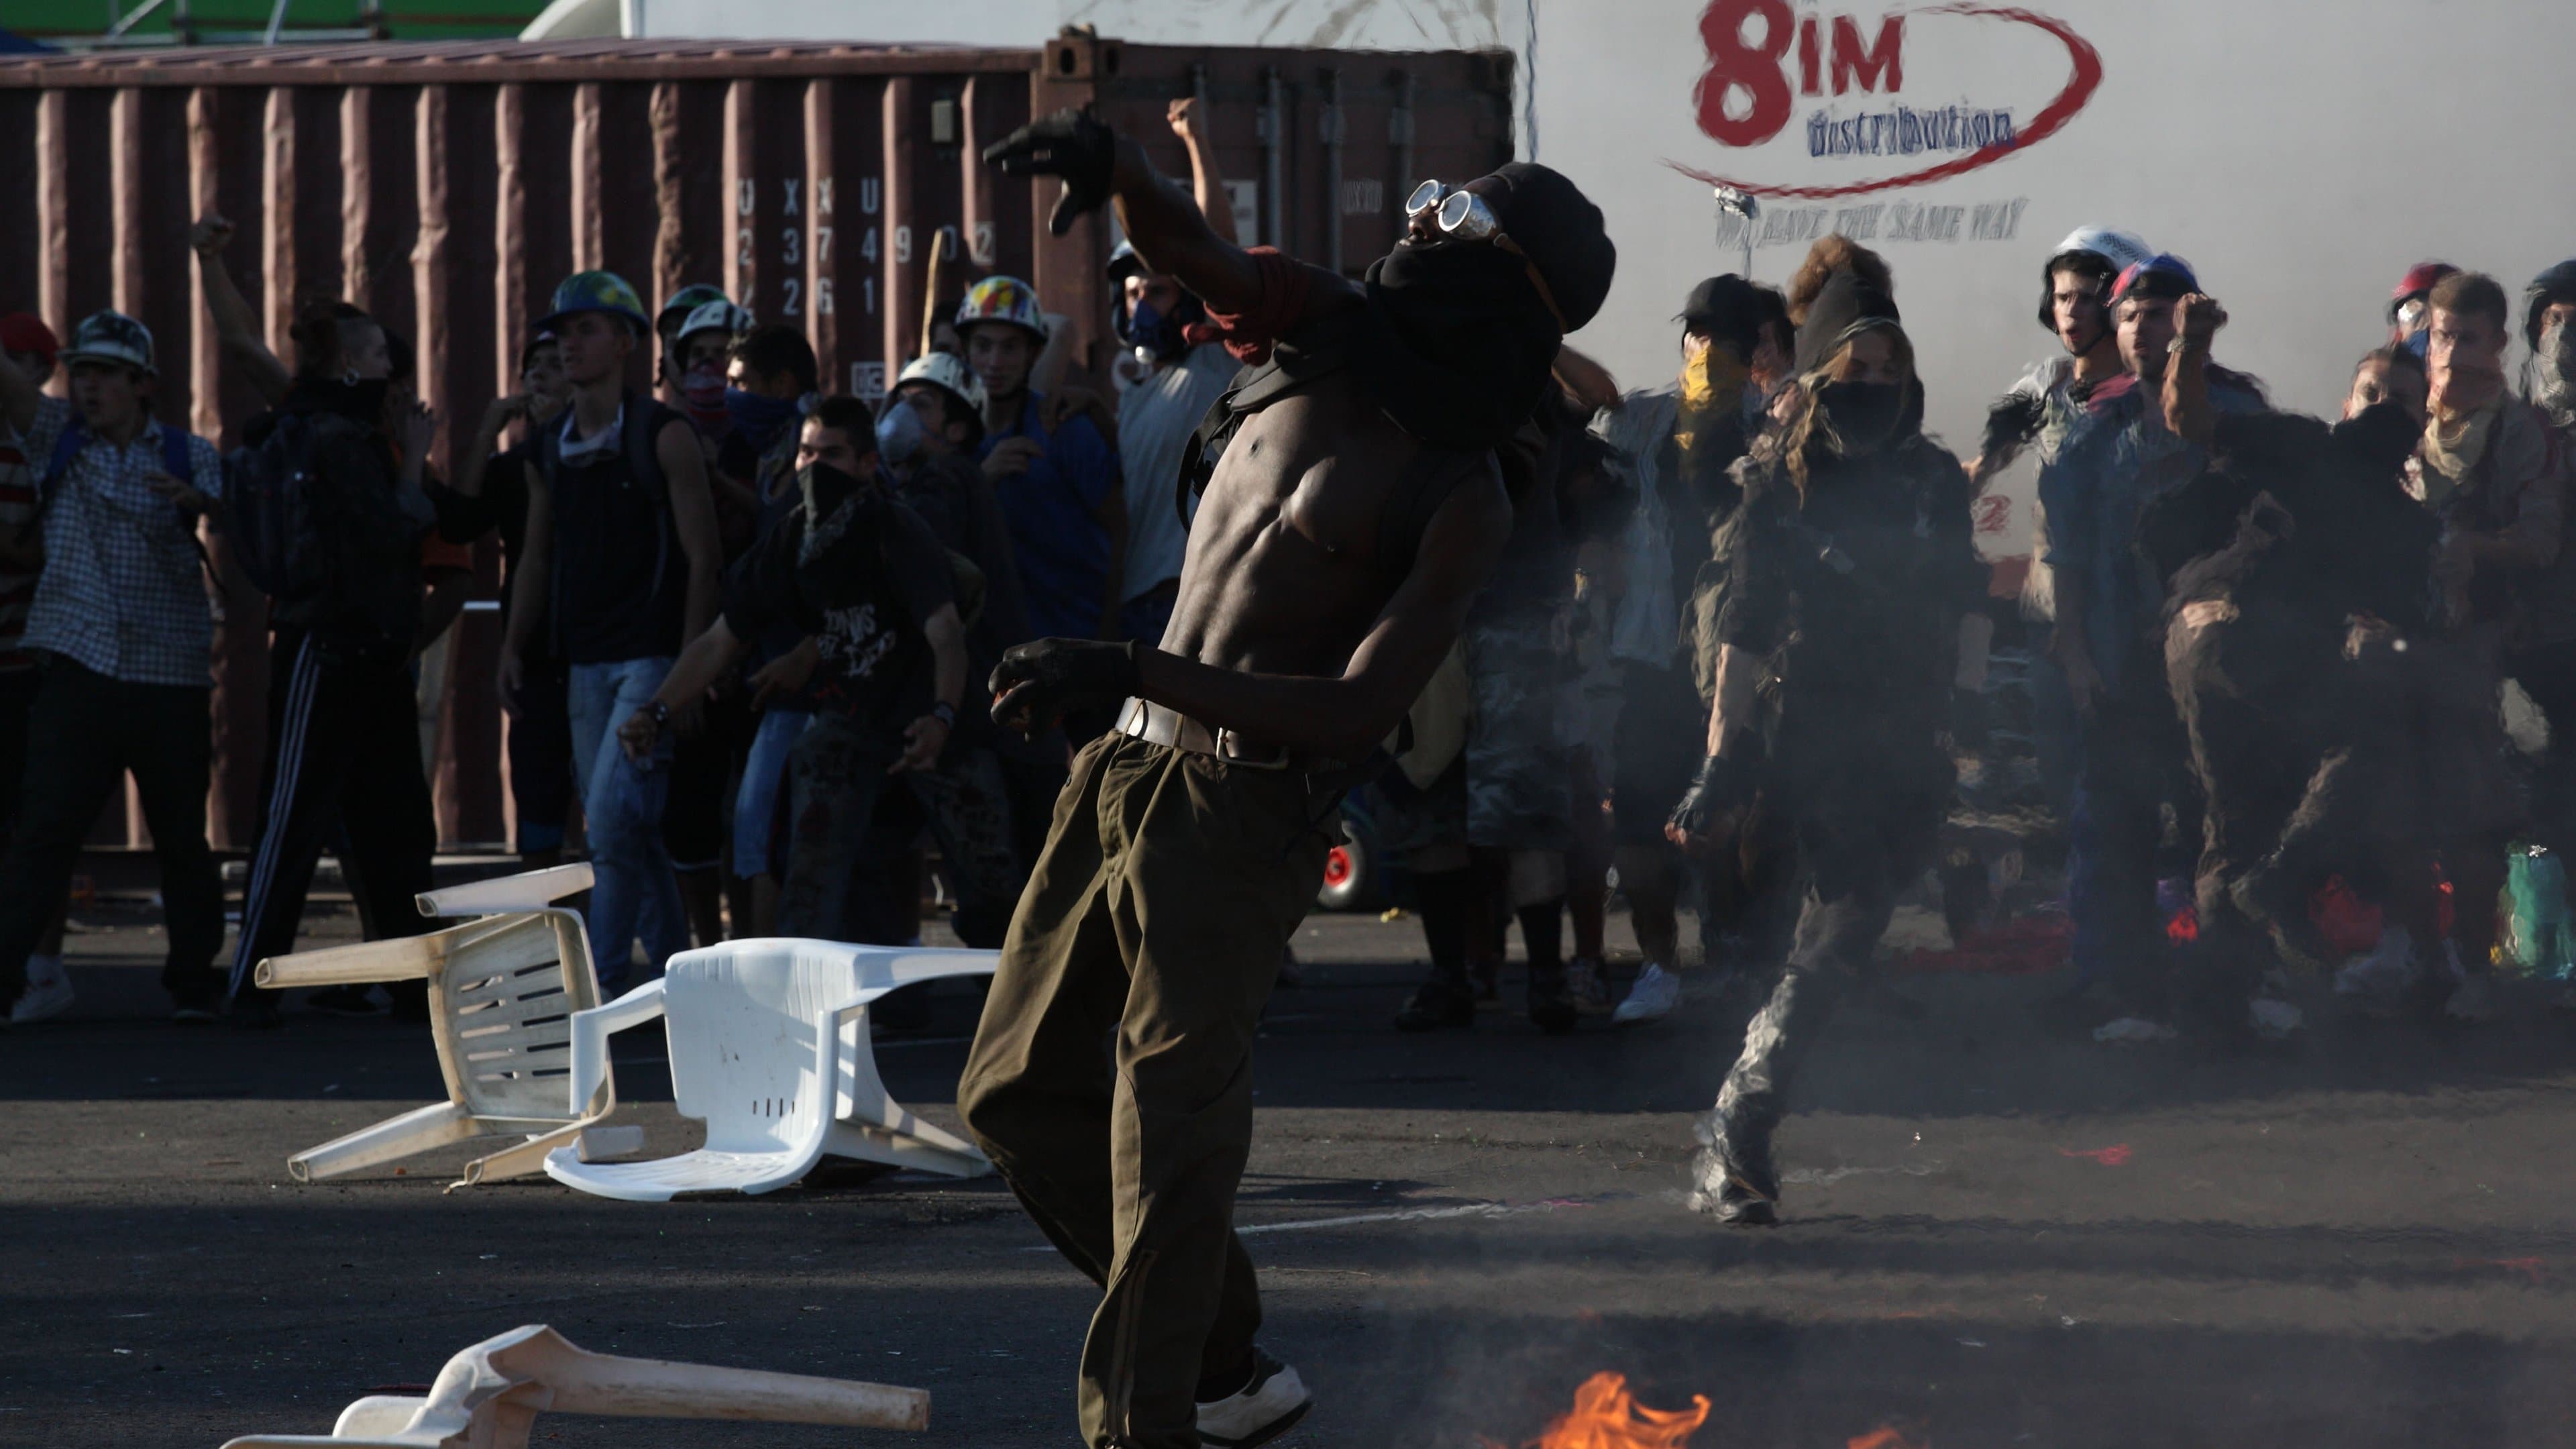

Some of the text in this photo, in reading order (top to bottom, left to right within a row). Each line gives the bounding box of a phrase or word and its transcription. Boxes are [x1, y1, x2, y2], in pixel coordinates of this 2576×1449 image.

[1807, 105, 2014, 156] distribution
[1887, 200, 1965, 243] SAME
[1969, 196, 2029, 241] WAY
